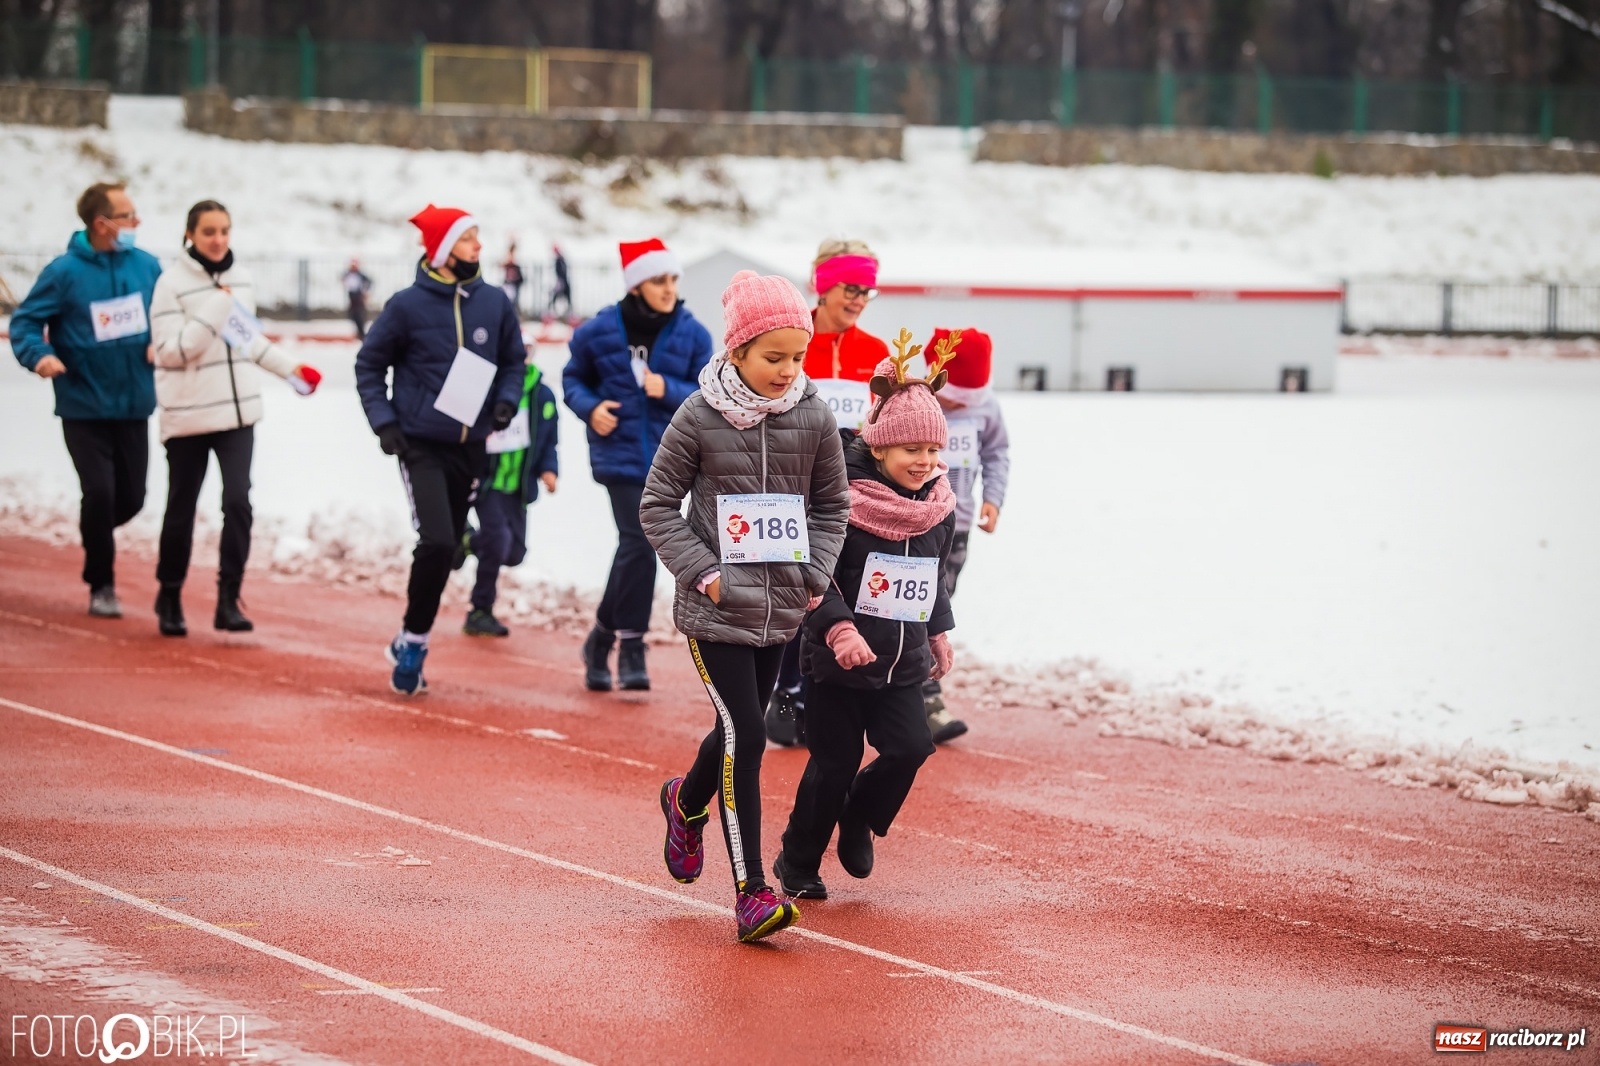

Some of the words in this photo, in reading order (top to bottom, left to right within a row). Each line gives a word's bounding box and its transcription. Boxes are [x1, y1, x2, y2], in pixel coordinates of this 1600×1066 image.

[828, 397, 865, 413] 087
[947, 435, 971, 452] 85
[752, 517, 799, 540] 186
[892, 578, 929, 602] 185
[724, 761, 733, 802] CHICAGO
